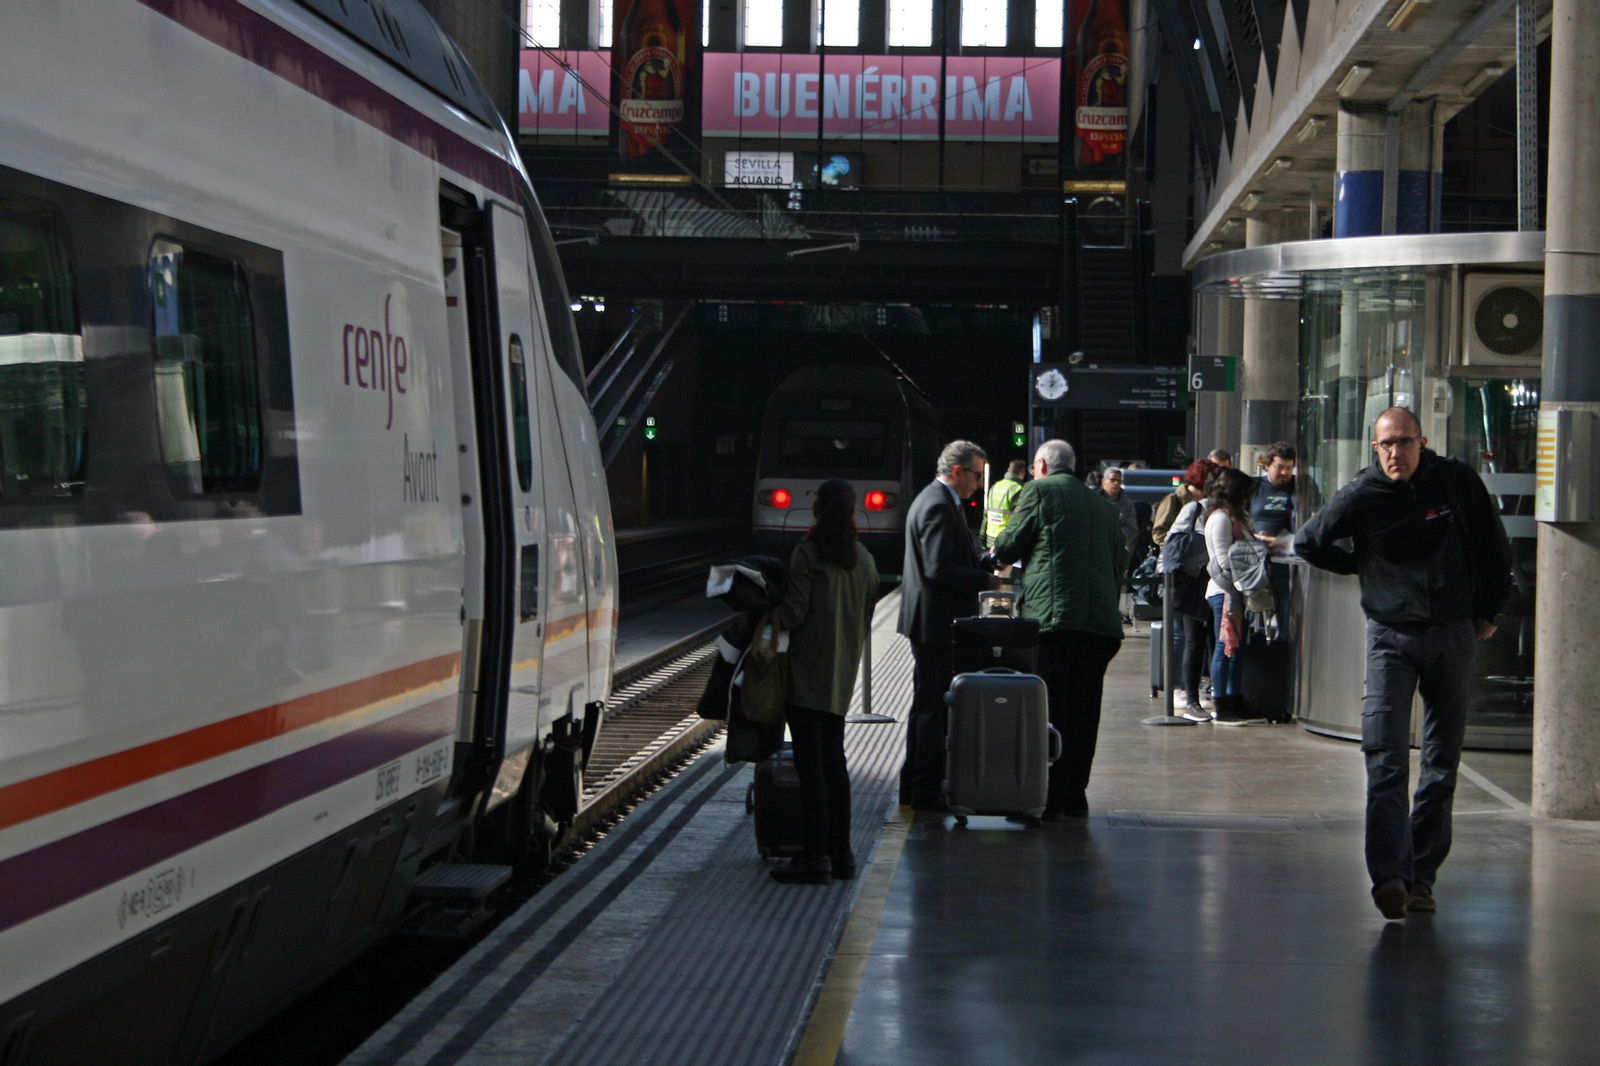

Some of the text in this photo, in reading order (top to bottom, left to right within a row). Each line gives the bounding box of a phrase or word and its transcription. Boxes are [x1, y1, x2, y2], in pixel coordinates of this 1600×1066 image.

[519, 68, 587, 115] MA
[733, 66, 1033, 122] BUENÉRRIMA
[1077, 109, 1128, 126] Cruzcam
[733, 175, 783, 185] ACUARIO
[734, 158, 782, 169] SEVILLA
[343, 293, 408, 430] renfe
[1191, 371, 1203, 390] 6
[403, 433, 440, 503] Avant
